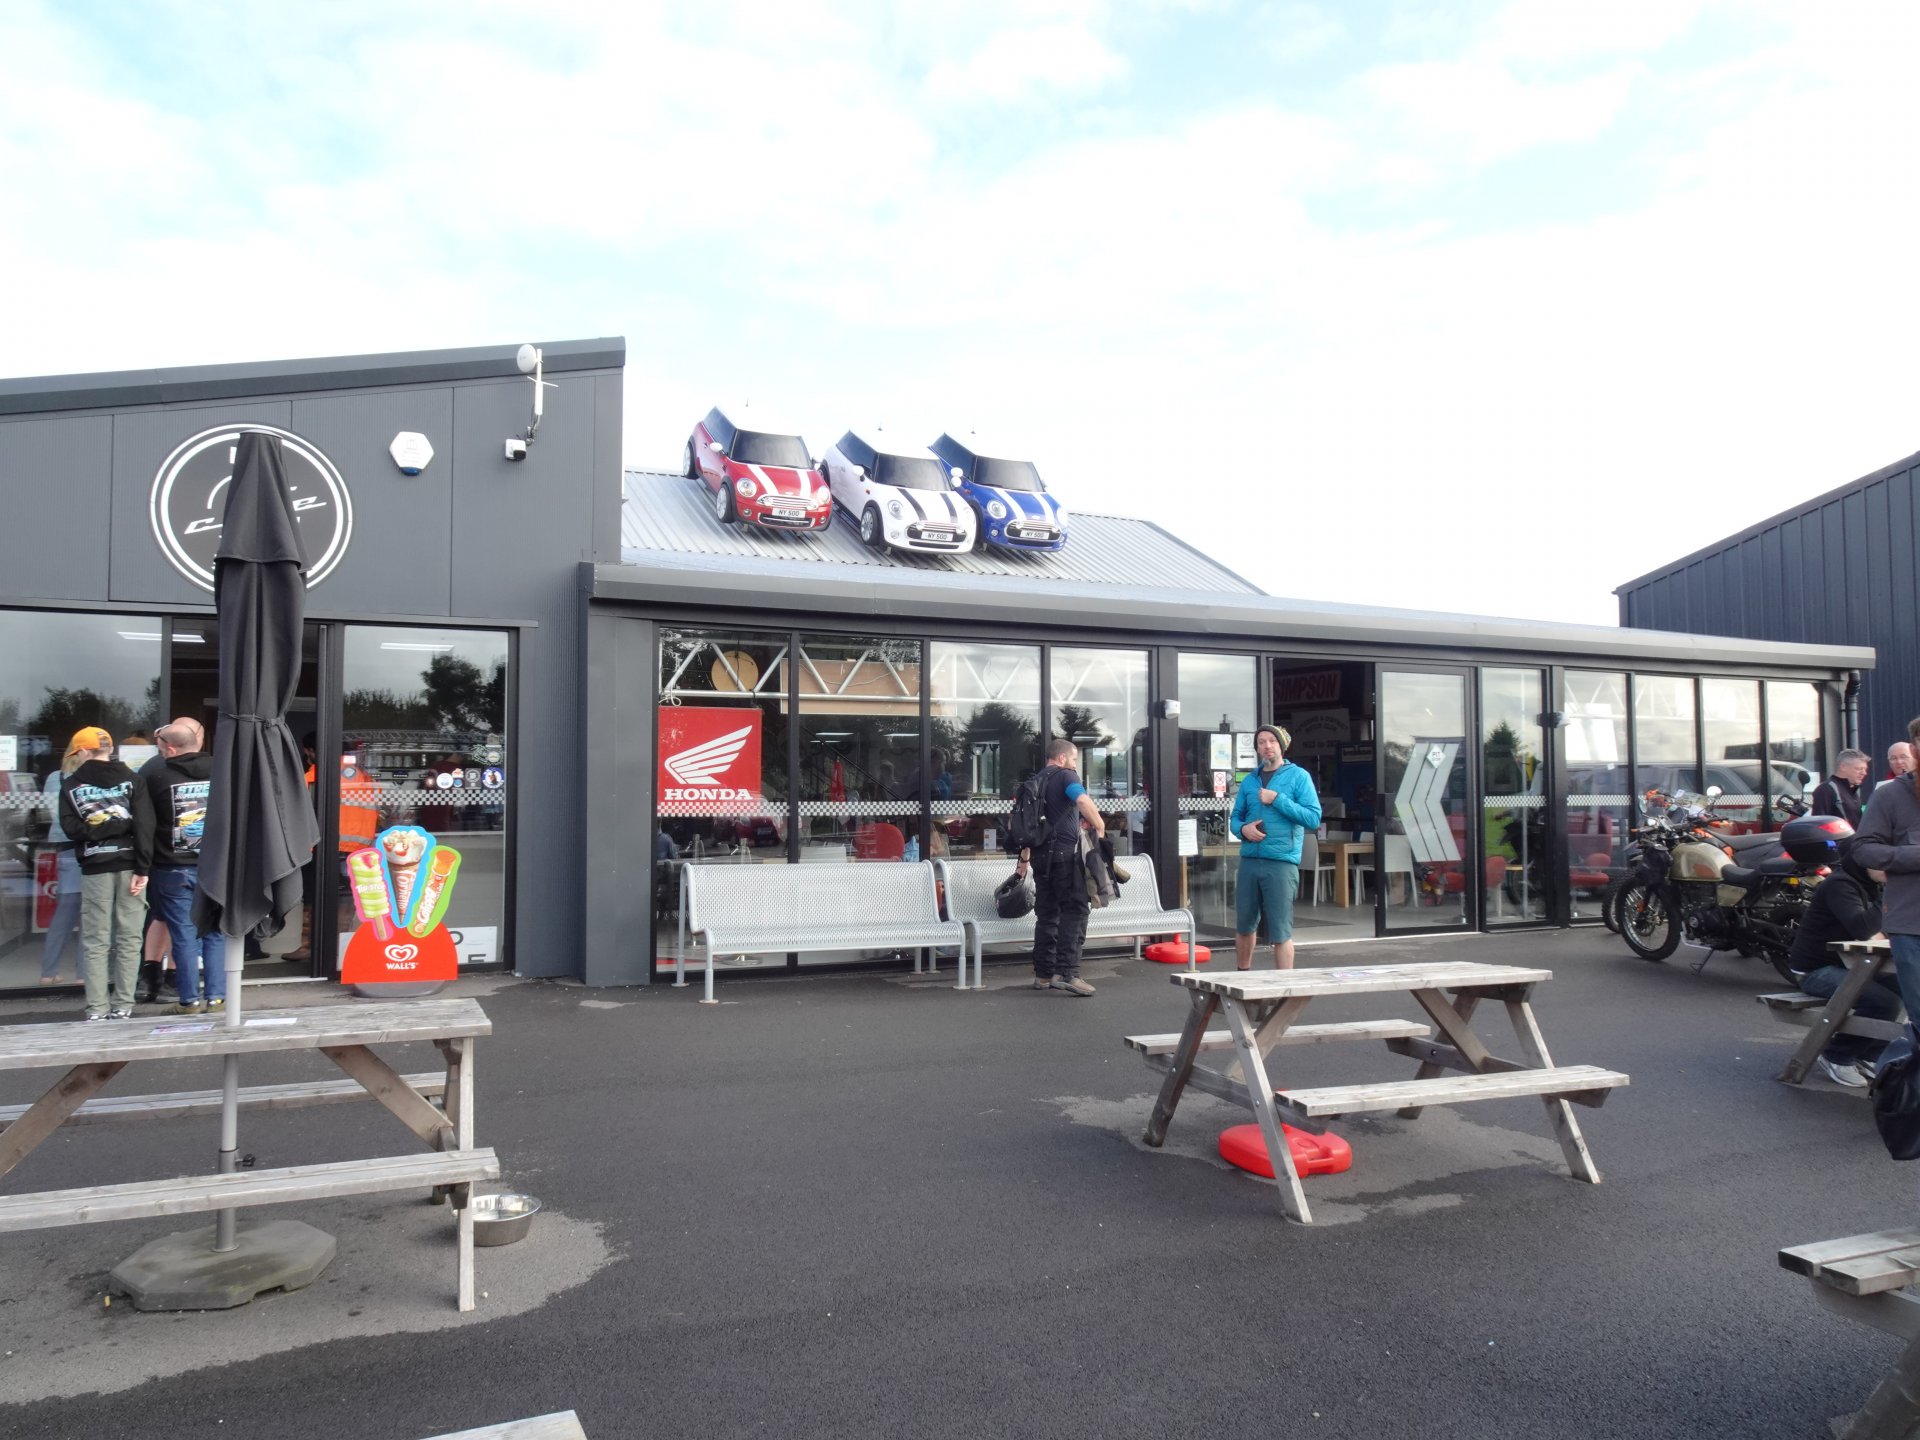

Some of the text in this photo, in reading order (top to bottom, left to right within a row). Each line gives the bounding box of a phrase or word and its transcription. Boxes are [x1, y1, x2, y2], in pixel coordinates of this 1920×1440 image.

[1274, 673, 1338, 702] SIMPSON
[177, 784, 210, 794] STRE
[664, 788, 753, 800] HONDA
